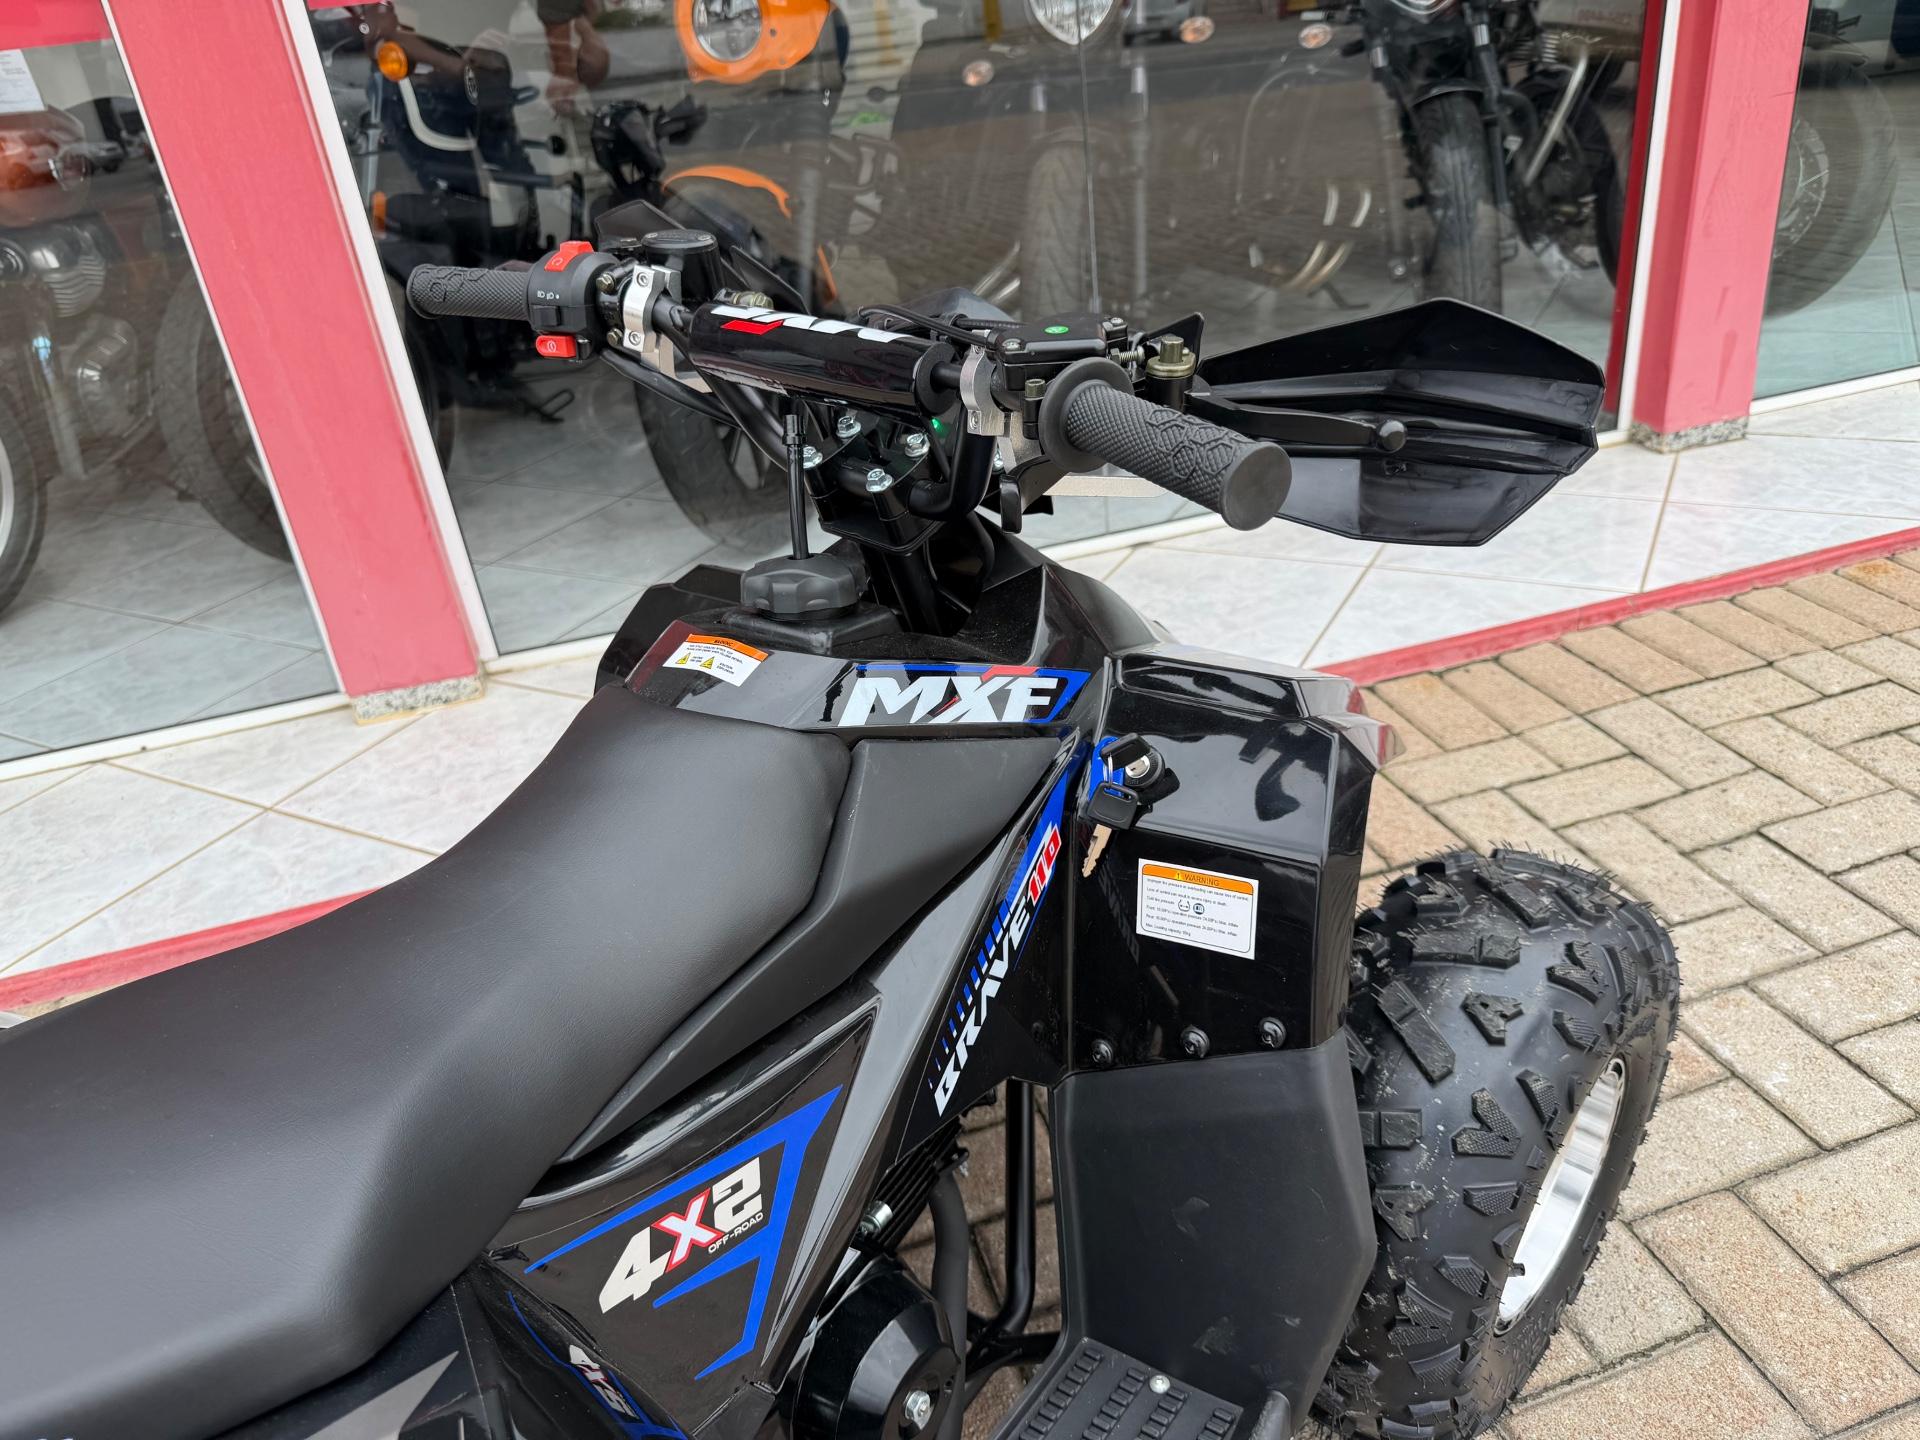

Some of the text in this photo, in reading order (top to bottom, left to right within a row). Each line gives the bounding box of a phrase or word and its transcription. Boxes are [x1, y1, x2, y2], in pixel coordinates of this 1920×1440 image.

[838, 675, 1059, 727] MXF
[1184, 872, 1220, 888] WARNING
[934, 824, 1062, 1118] BRAVE 110
[598, 1156, 763, 1315] 4X2
[707, 1211, 764, 1255] OFF-ROAD
